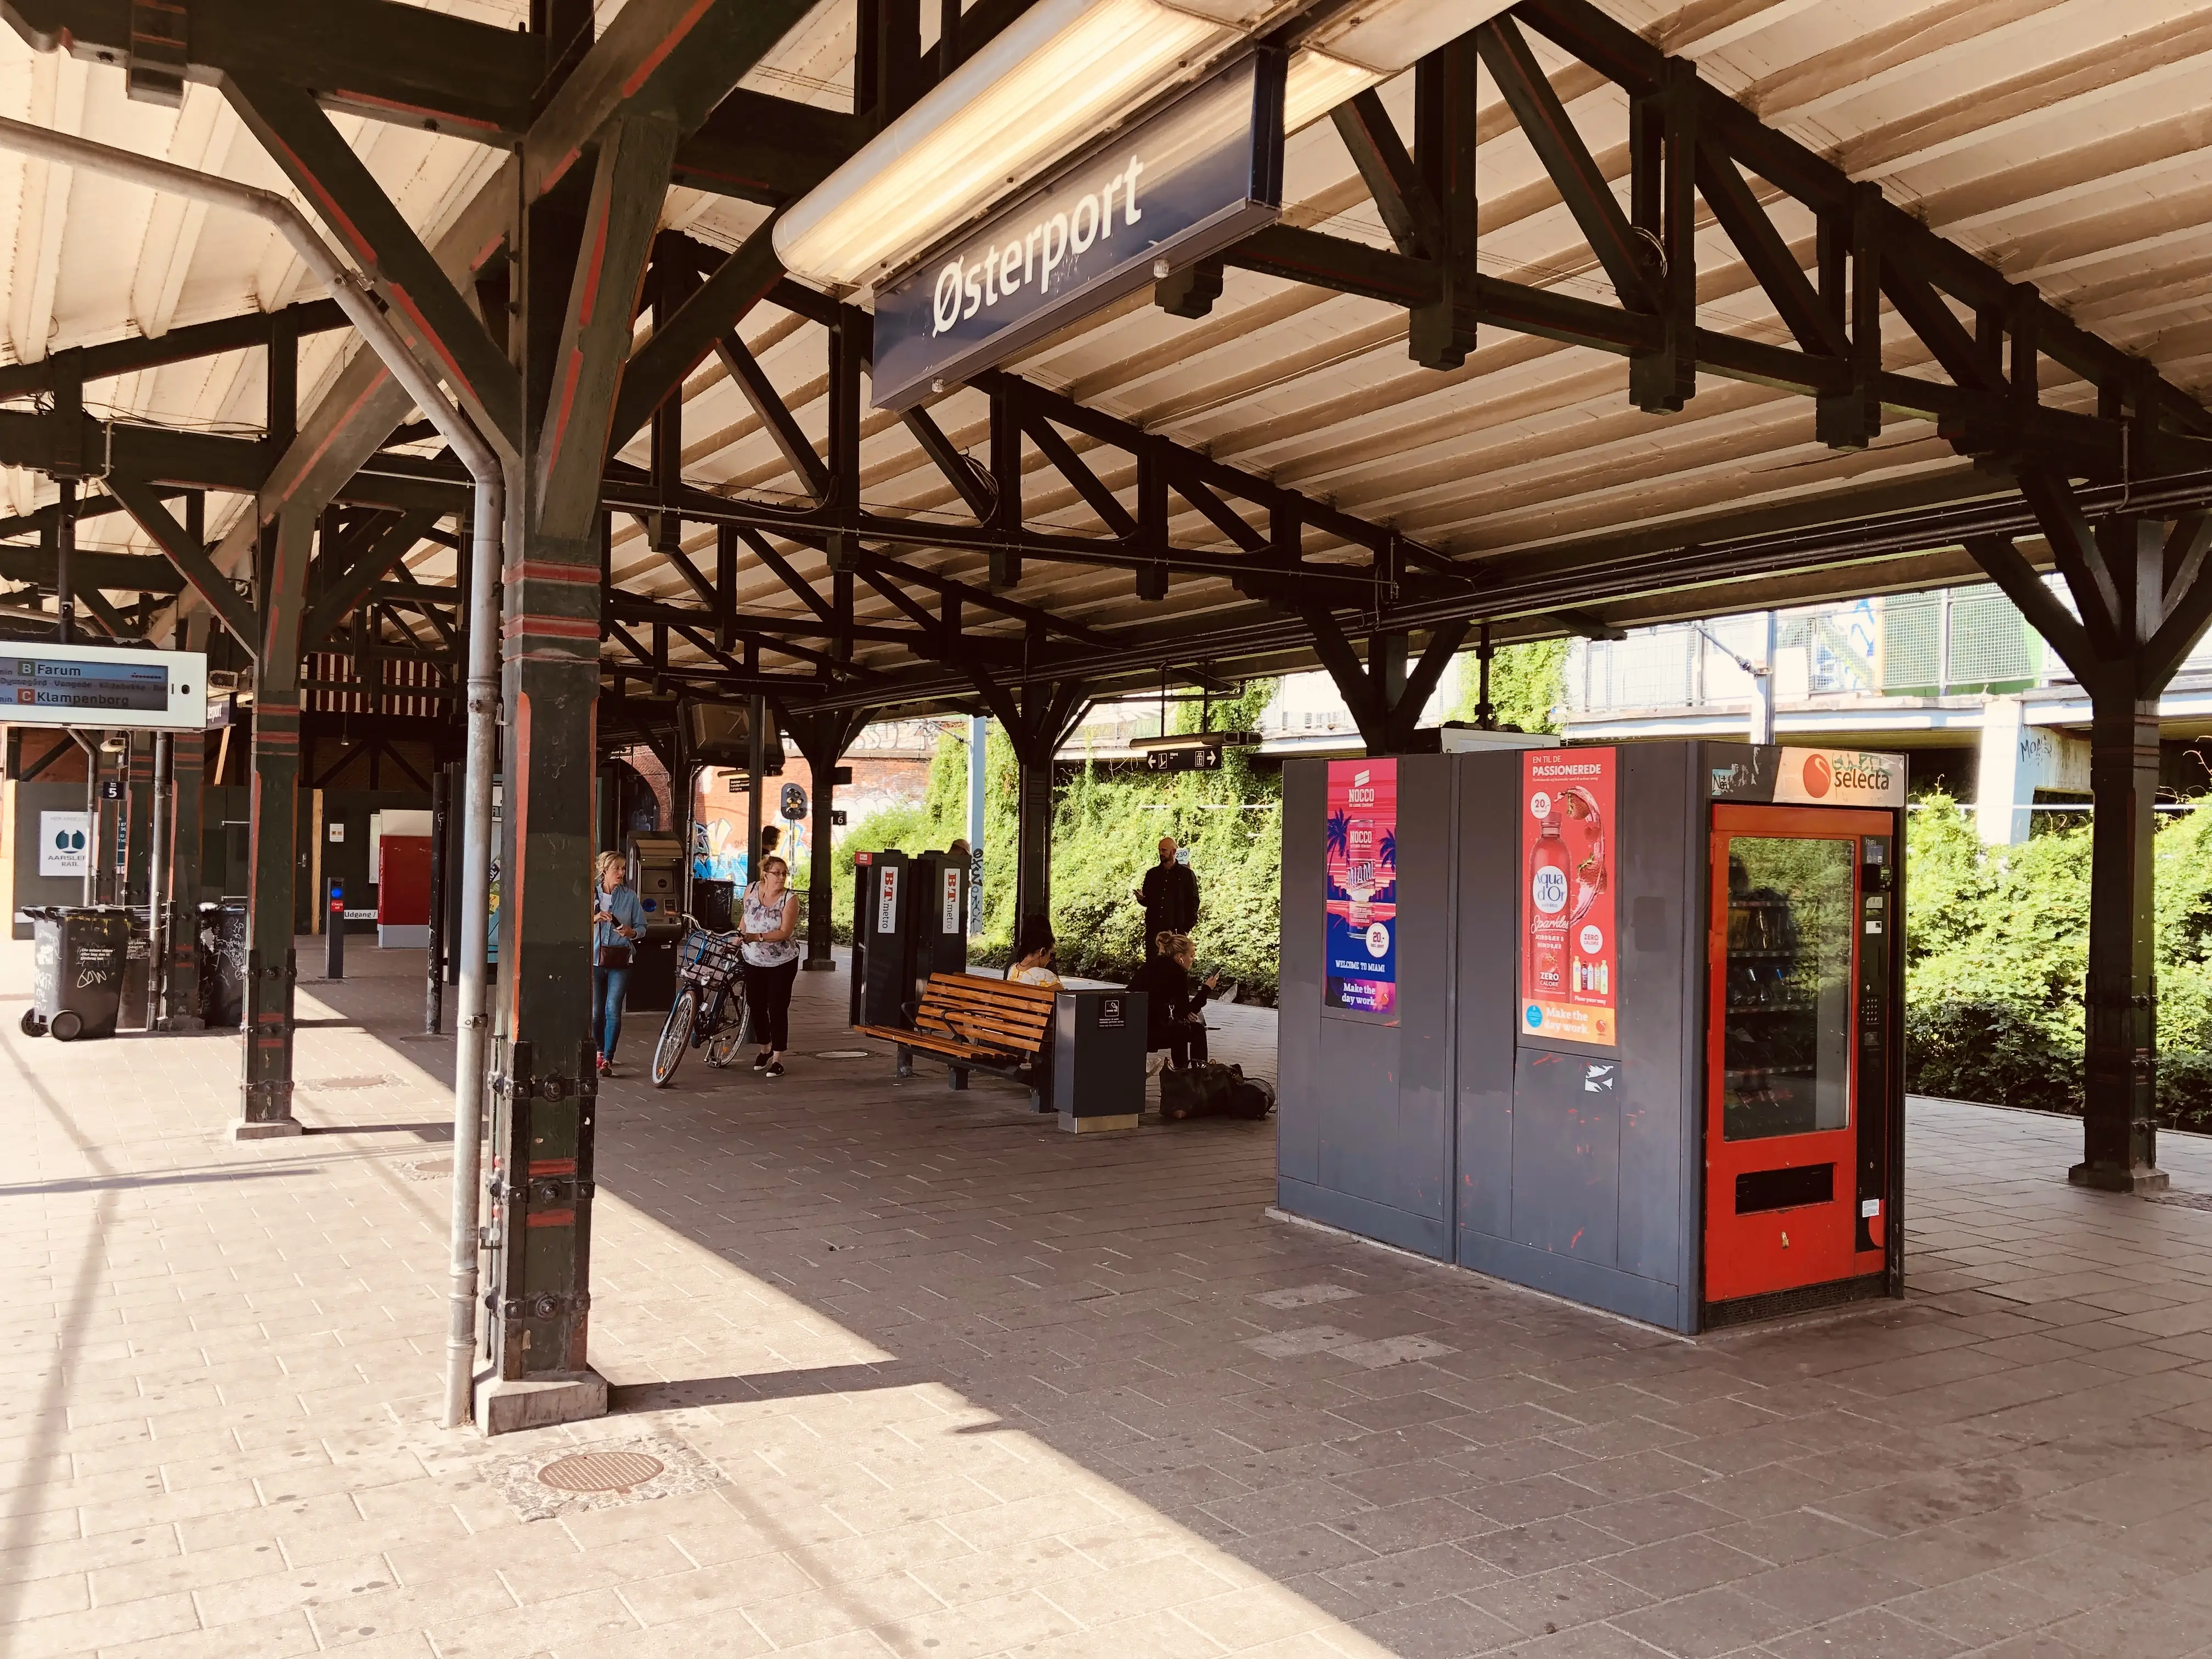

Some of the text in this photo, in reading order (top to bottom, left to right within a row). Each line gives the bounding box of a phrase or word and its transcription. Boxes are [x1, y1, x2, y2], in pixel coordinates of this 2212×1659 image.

[933, 154, 1143, 338] Østerport
[22, 663, 31, 674] B
[38, 664, 81, 676] Farum
[22, 691, 31, 701] C
[37, 691, 129, 707] Klampenborg
[1532, 764, 1602, 776] PASSIONEREDE
[1834, 768, 1889, 790] selecta
[109, 788, 117, 798] 5
[1348, 788, 1375, 803] NOCCO
[838, 816, 843, 824] 6
[1350, 831, 1372, 844] NOCCO
[1531, 915, 1570, 934] Sparkles
[1335, 960, 1385, 972] WELCOME TO MIAMI
[1540, 972, 1559, 981] ZERO
[1344, 983, 1376, 995] Make the
[1341, 993, 1377, 1006] day work.
[1547, 1007, 1572, 1019] Make
[1572, 1010, 1589, 1022] the
[1544, 1019, 1561, 1033] day
